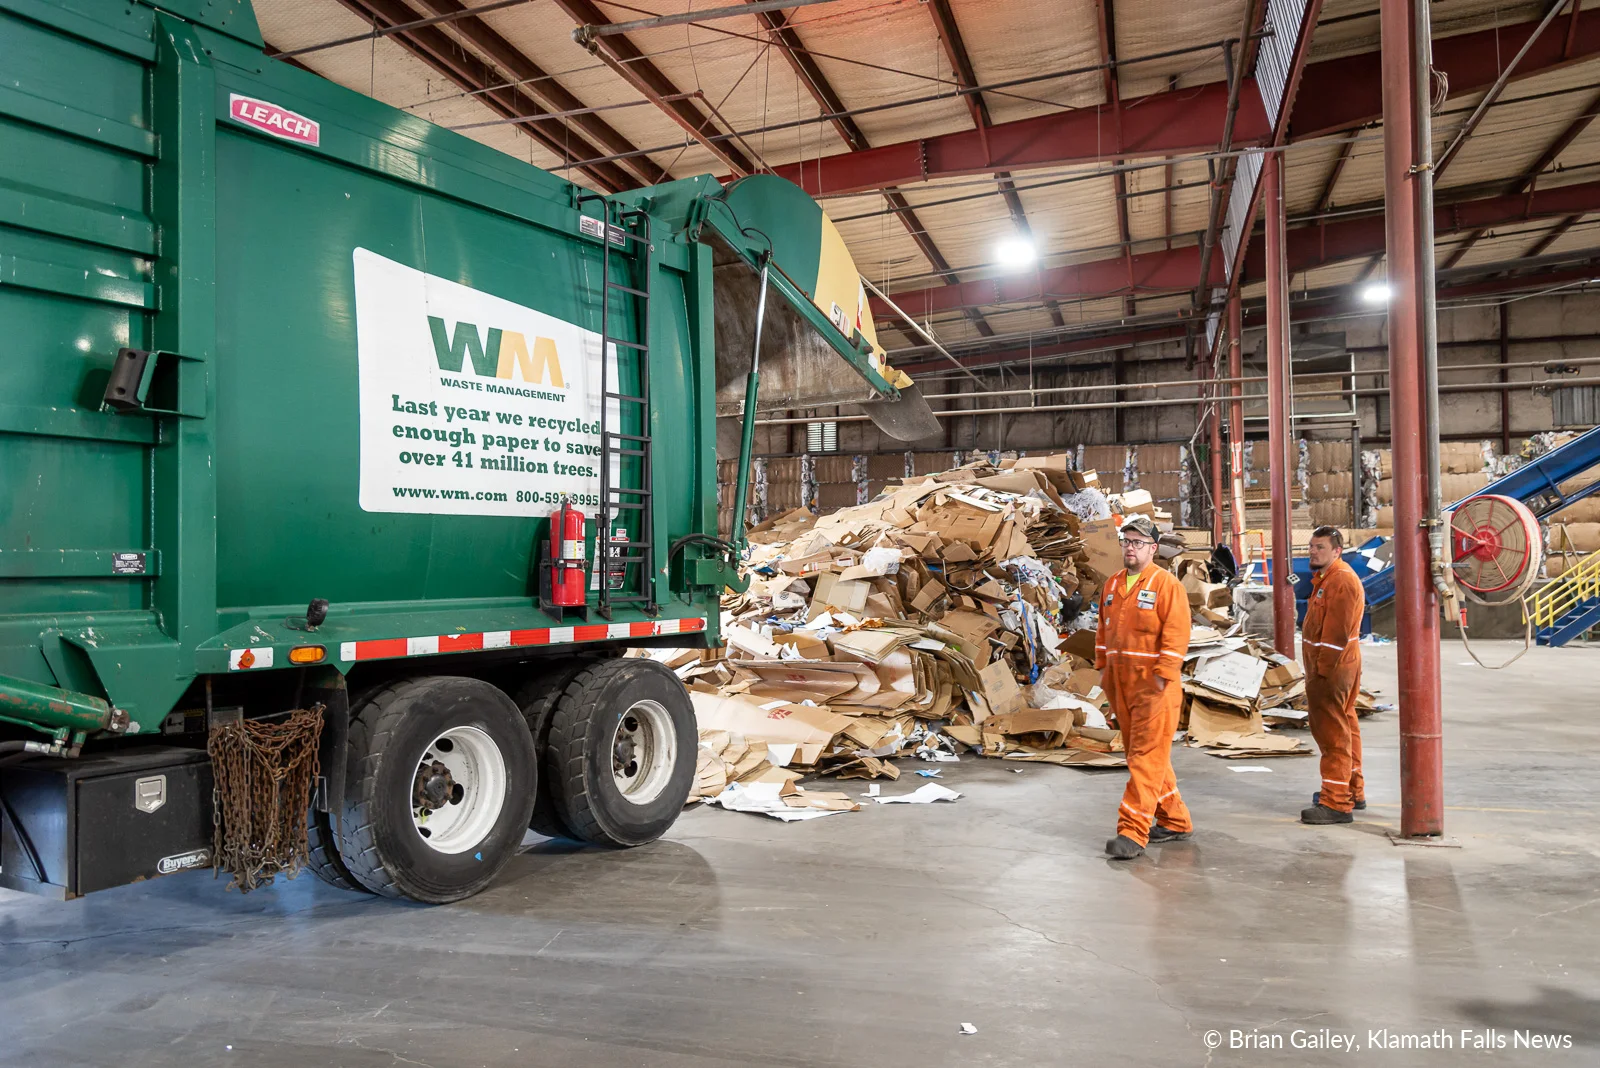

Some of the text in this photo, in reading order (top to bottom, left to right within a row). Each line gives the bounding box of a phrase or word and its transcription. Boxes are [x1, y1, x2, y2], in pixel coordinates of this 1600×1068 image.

[240, 101, 312, 138] LEACH
[427, 315, 565, 389] WM
[440, 377, 566, 403] WASTE MANAGEMENT
[391, 394, 602, 436] Last year we recycled
[392, 424, 602, 457] enough paper to save
[399, 449, 599, 479] over 41 million trees.
[392, 486, 600, 507] www.wm.com 800-5939995
[163, 854, 197, 870] Buyers
